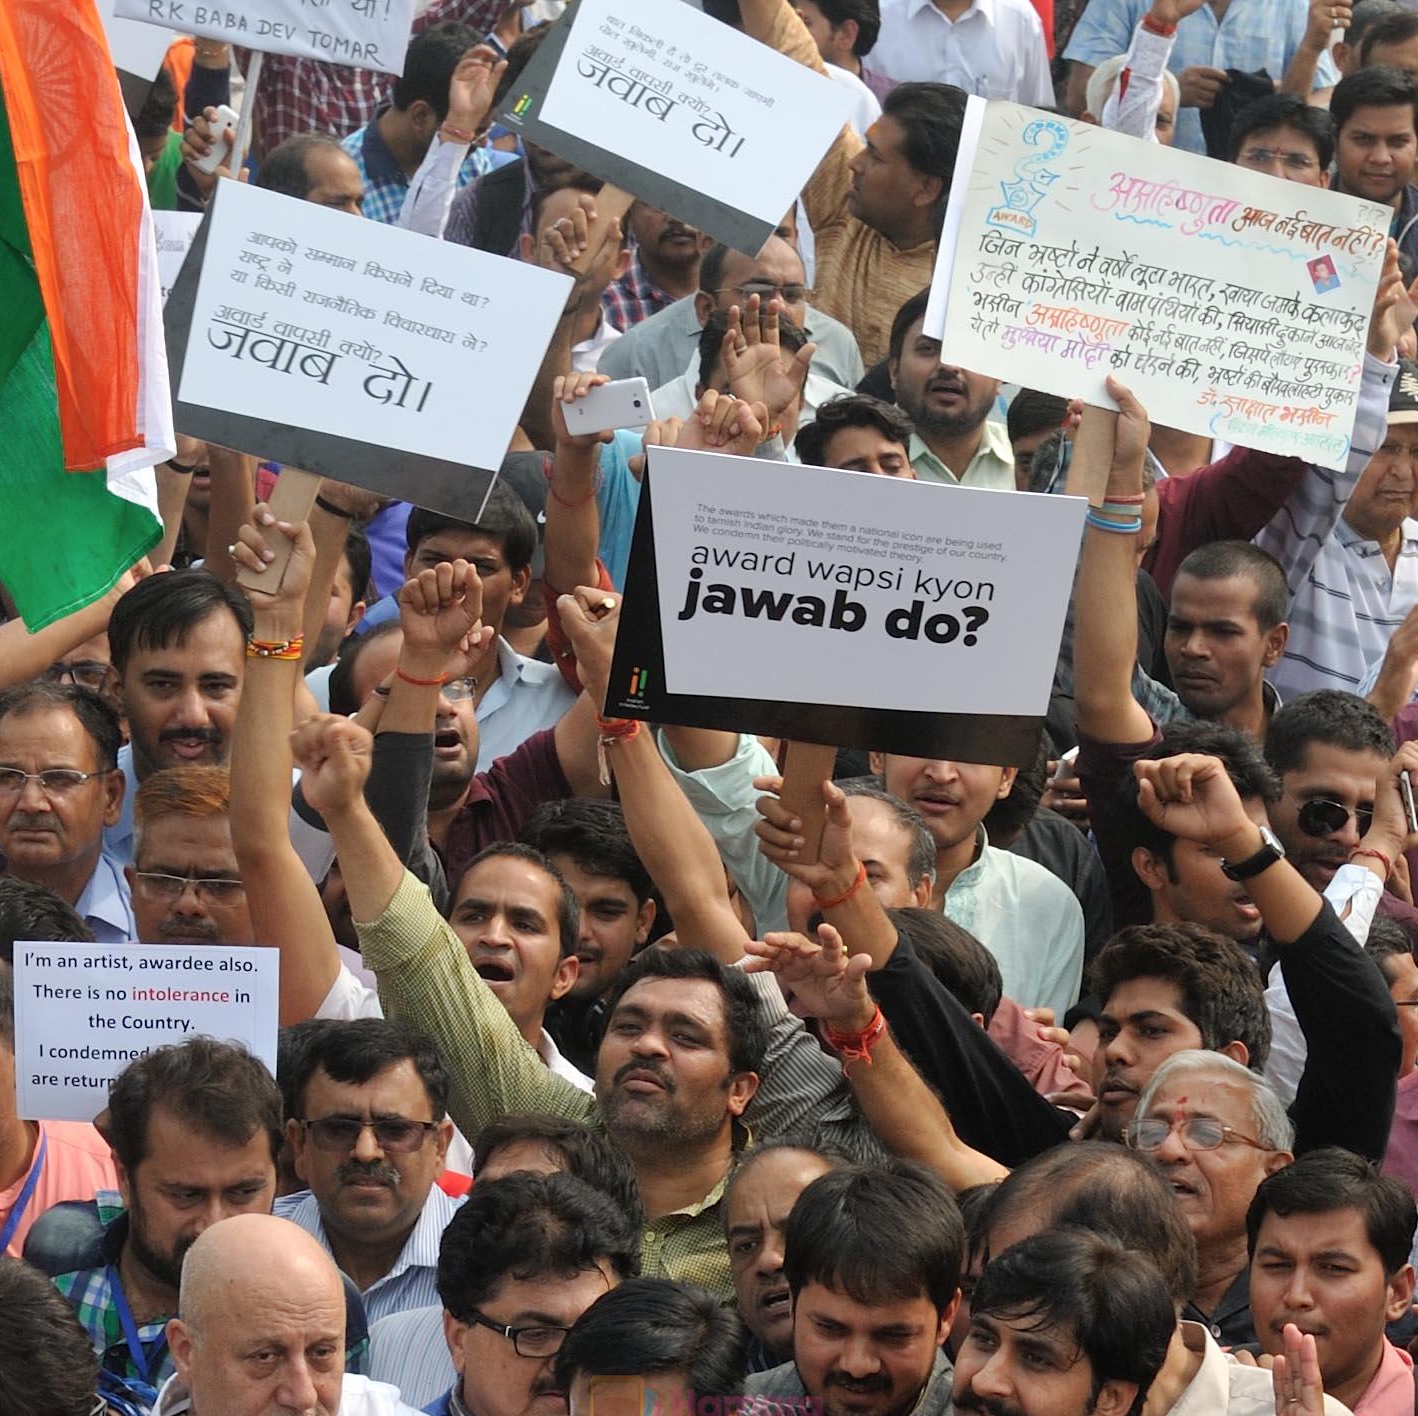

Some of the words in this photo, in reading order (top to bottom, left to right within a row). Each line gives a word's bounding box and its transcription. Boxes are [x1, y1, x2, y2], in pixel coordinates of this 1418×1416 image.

[195, 7, 248, 30] BABA
[256, 19, 297, 40] DEV
[308, 30, 385, 67] TOMAR
[577, 52, 682, 122] जवाब
[978, 230, 1025, 255] जिन
[248, 232, 298, 256] आपको
[304, 248, 357, 271] सम्मान
[362, 262, 415, 288] किसने
[419, 277, 456, 299] दिया
[461, 292, 490, 308] था?
[214, 305, 267, 329] अवार्ड
[274, 320, 331, 349] वापसी
[208, 318, 342, 386] जवाब
[363, 355, 433, 413] दो।
[697, 504, 715, 513] The
[719, 508, 755, 519] awards
[758, 512, 787, 523] which
[790, 517, 819, 527] made
[822, 520, 847, 531] them
[859, 525, 899, 538] national
[901, 532, 923, 542] icon
[945, 538, 974, 549] being
[977, 541, 1002, 550] used
[708, 516, 741, 526] tarnish
[744, 520, 774, 531] Indian
[827, 532, 854, 542] stand
[857, 535, 871, 544] for
[873, 538, 889, 547] the
[893, 542, 933, 554] prestige
[950, 549, 966, 557] our
[712, 527, 760, 540] condemn
[763, 533, 785, 543] their
[787, 537, 833, 551] politically
[837, 543, 887, 558] motivated
[692, 546, 795, 576] award
[807, 559, 904, 591] wapsi
[914, 569, 995, 603] kyon
[678, 567, 867, 633] jawab
[885, 600, 990, 647] do?
[25, 952, 51, 967] I'm
[57, 956, 77, 968] an
[83, 954, 133, 972] artist,
[139, 956, 213, 972] awardee
[219, 957, 258, 972] also.
[33, 984, 82, 1000] There
[88, 986, 101, 1000] is
[106, 989, 127, 1000] no
[133, 987, 229, 1003] intolerance
[235, 989, 251, 1003] in
[89, 1014, 116, 1029] the
[122, 1016, 195, 1032] Country.
[31, 1075, 58, 1086] are
